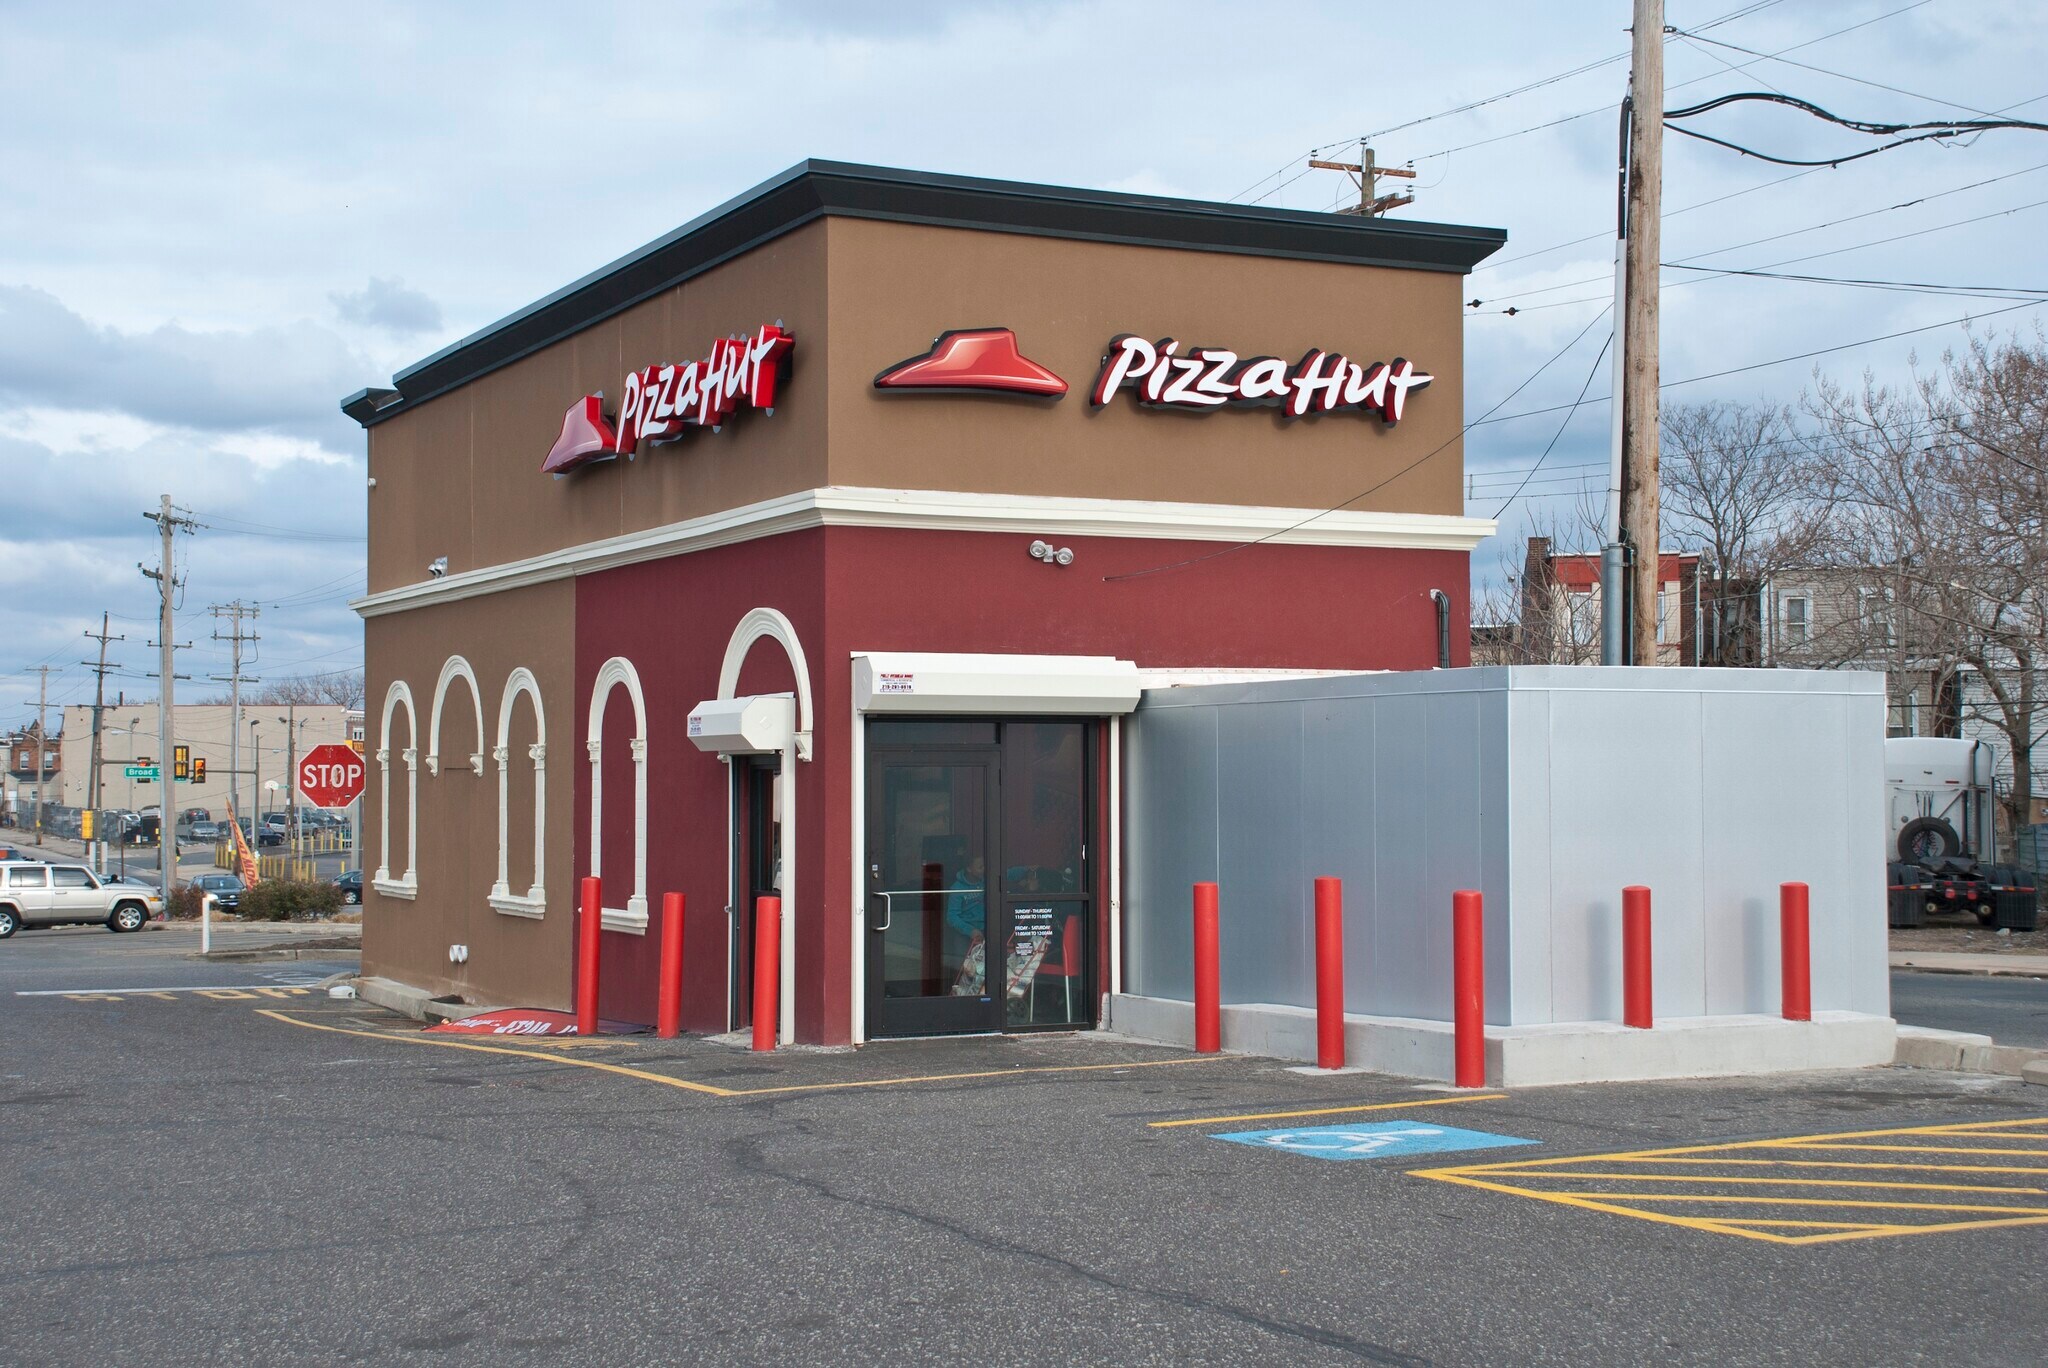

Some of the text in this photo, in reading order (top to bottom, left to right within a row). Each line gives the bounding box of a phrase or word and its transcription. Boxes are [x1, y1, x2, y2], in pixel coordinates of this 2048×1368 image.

[616, 325, 777, 453] Pizza Hut
[1102, 337, 1435, 421] Pizza Hut
[128, 768, 153, 776] Broad
[303, 764, 362, 788] STOP
